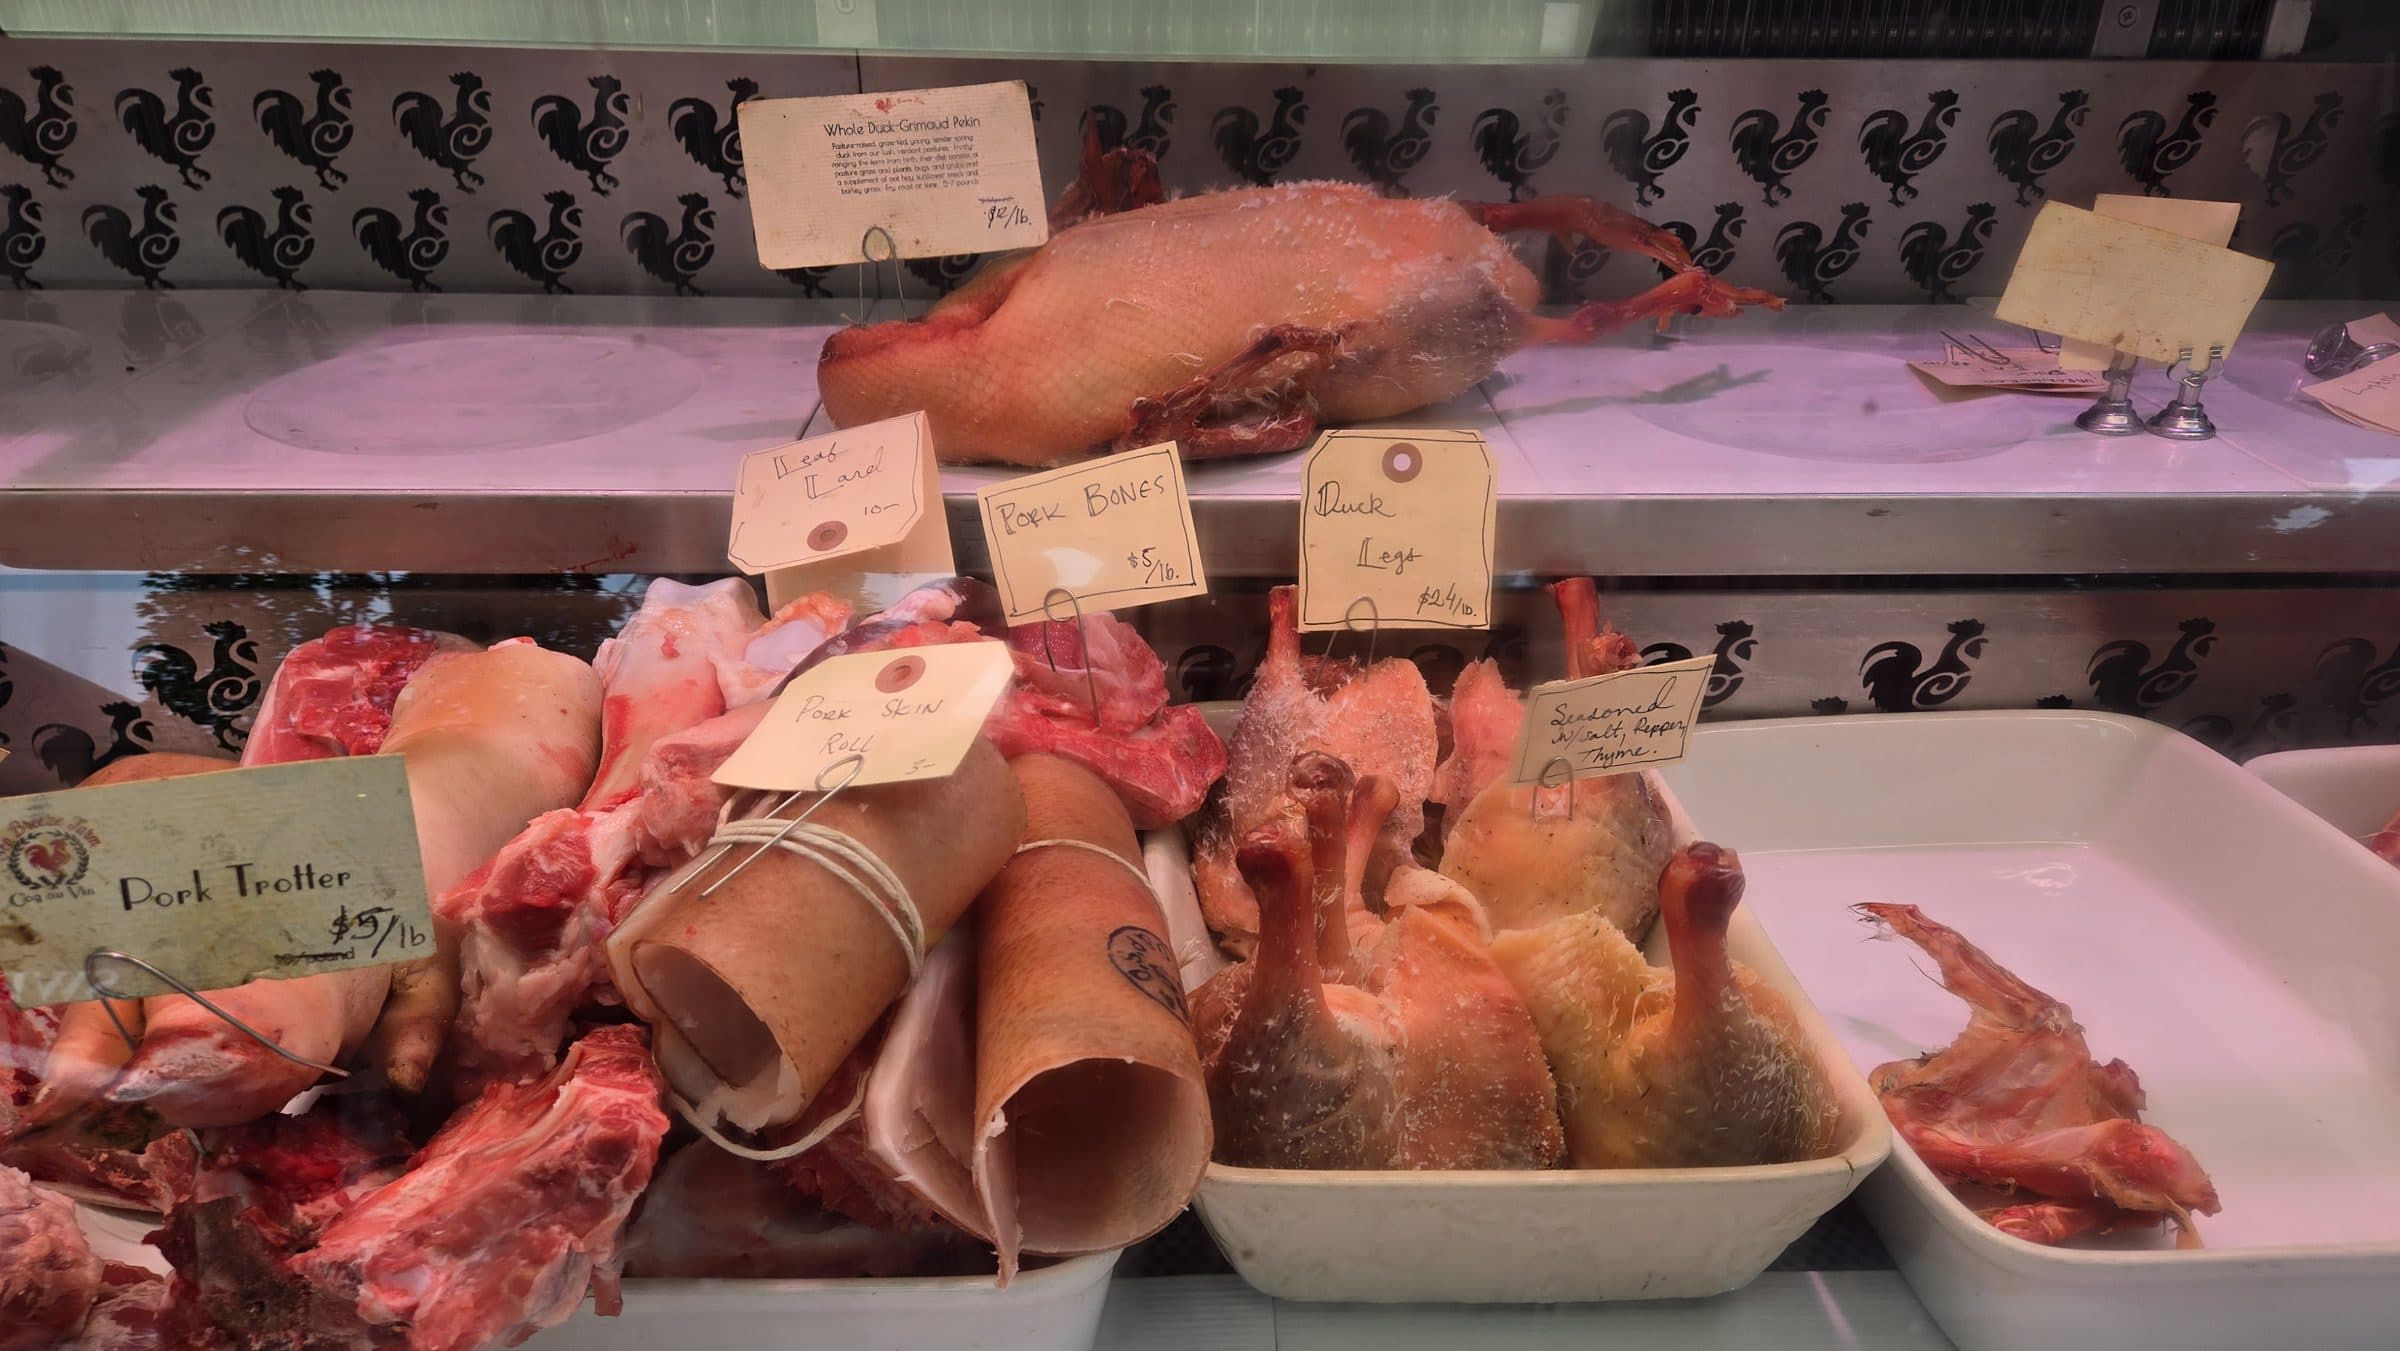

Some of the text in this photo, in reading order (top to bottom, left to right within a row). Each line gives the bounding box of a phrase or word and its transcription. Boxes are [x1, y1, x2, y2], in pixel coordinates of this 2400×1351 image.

[824, 122, 864, 137] Whole
[953, 114, 981, 129] Pekin
[852, 150, 867, 158] from
[878, 166, 892, 174] and
[932, 162, 945, 171] and
[965, 160, 978, 168] and
[965, 168, 979, 176] and
[773, 441, 848, 480] Leaf
[804, 445, 884, 500] Lard
[1313, 480, 1396, 518] Duck
[1356, 536, 1423, 576] Legs
[880, 697, 944, 719] SKIN
[1550, 675, 1676, 727] Seasoned
[819, 731, 874, 756] ROLL
[67, 815, 102, 848] Farm
[9, 892, 43, 908] Coq
[66, 885, 96, 899] Vin
[119, 862, 351, 912] Pork Trotter
